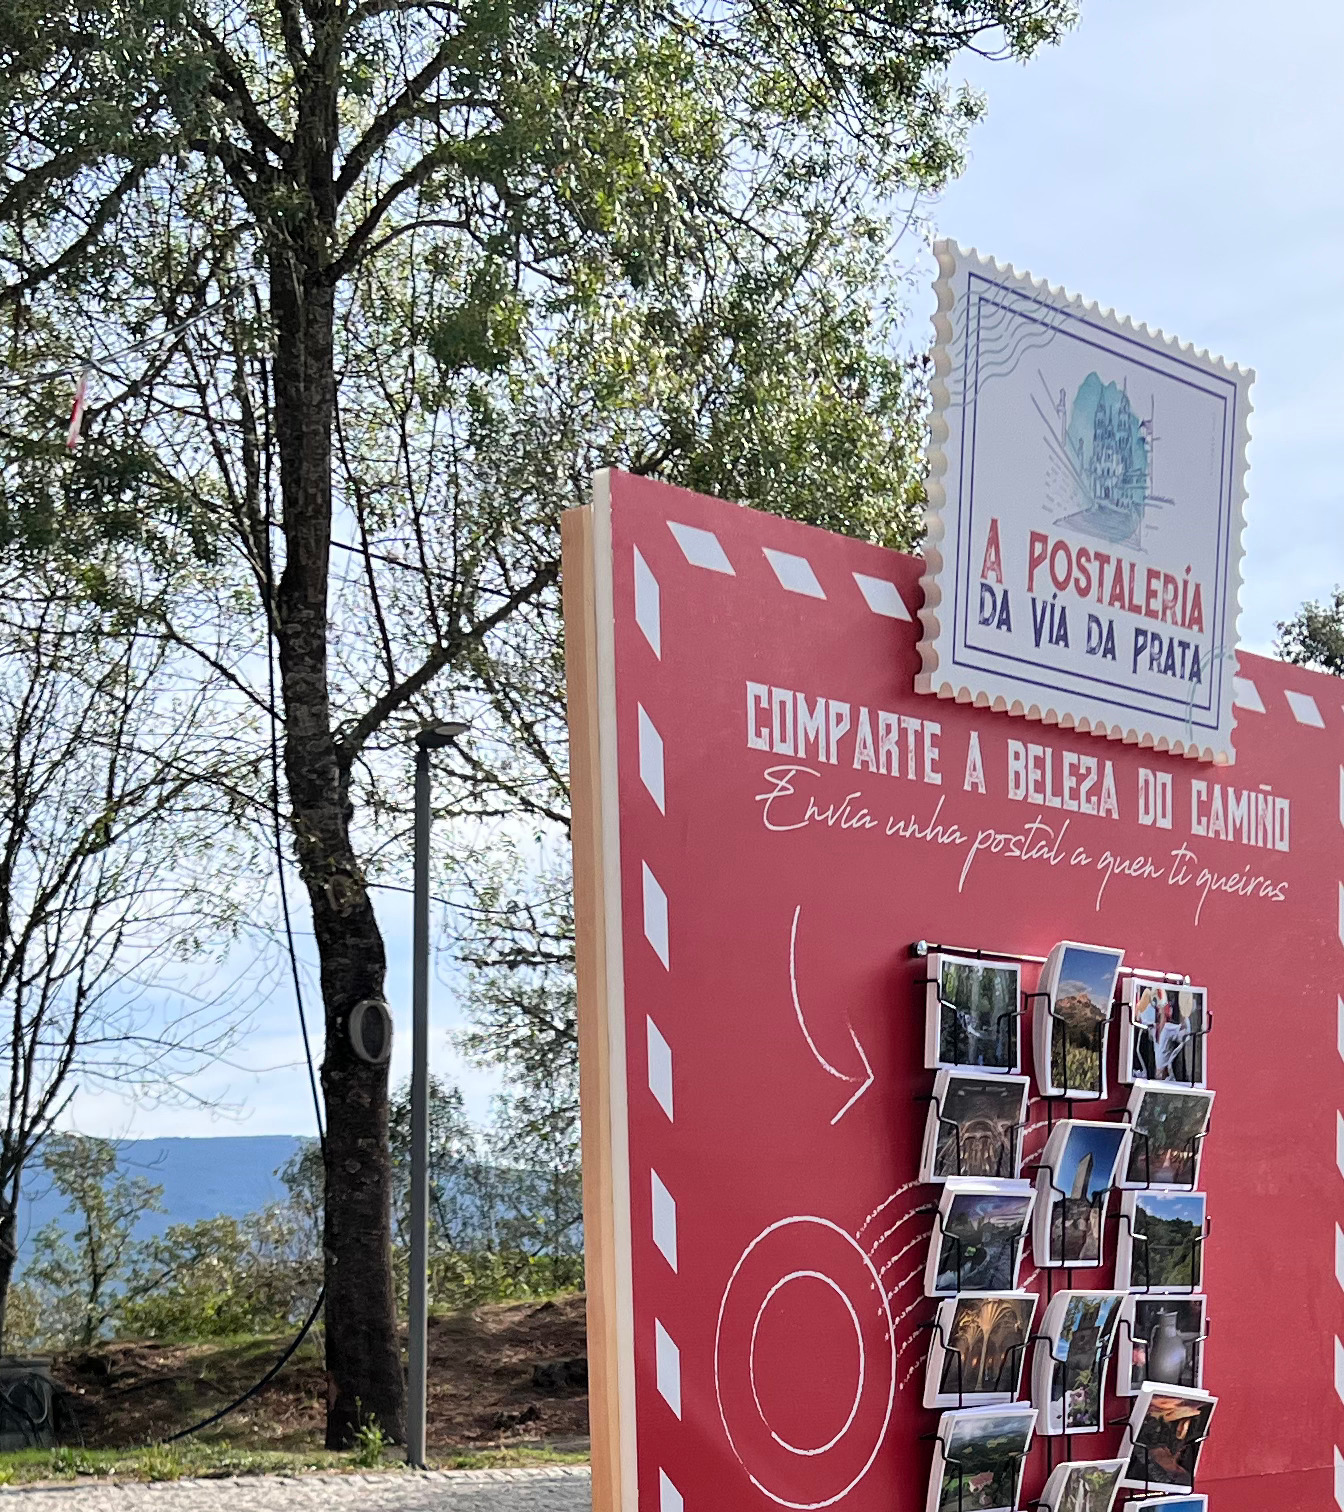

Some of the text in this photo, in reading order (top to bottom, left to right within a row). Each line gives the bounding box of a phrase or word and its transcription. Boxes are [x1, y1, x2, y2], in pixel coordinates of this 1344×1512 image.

[978, 581, 1202, 684] DA VÍA DA PRATA
[980, 517, 1204, 633] A POSTALERÍA
[746, 680, 1290, 852] COMPARTE A BELEZA DO CAMIÑO
[755, 765, 1289, 926] Envía unha postal a quen ti queiras
